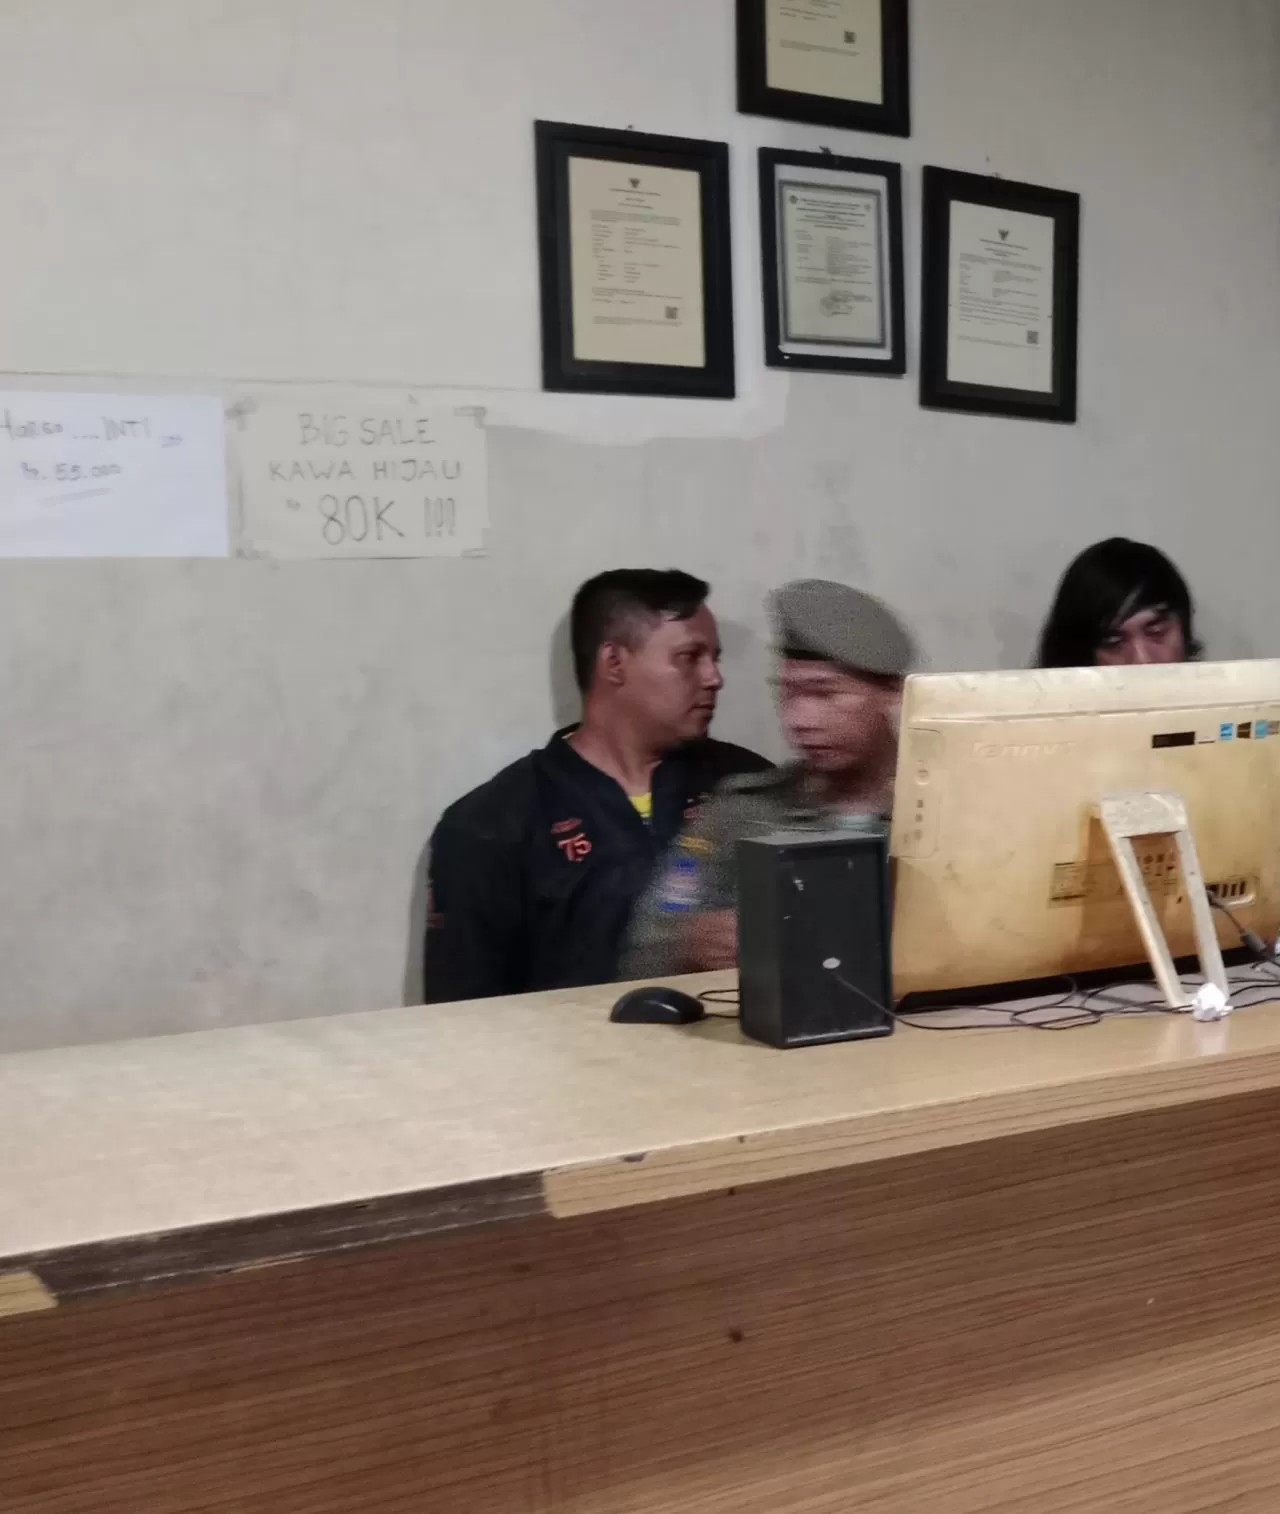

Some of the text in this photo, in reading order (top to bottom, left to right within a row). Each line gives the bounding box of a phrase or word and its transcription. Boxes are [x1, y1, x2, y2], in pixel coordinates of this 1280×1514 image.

[298, 413, 436, 447] BIG SALE
[269, 459, 461, 482] KAWA HIJAU
[318, 494, 405, 545] 80K
